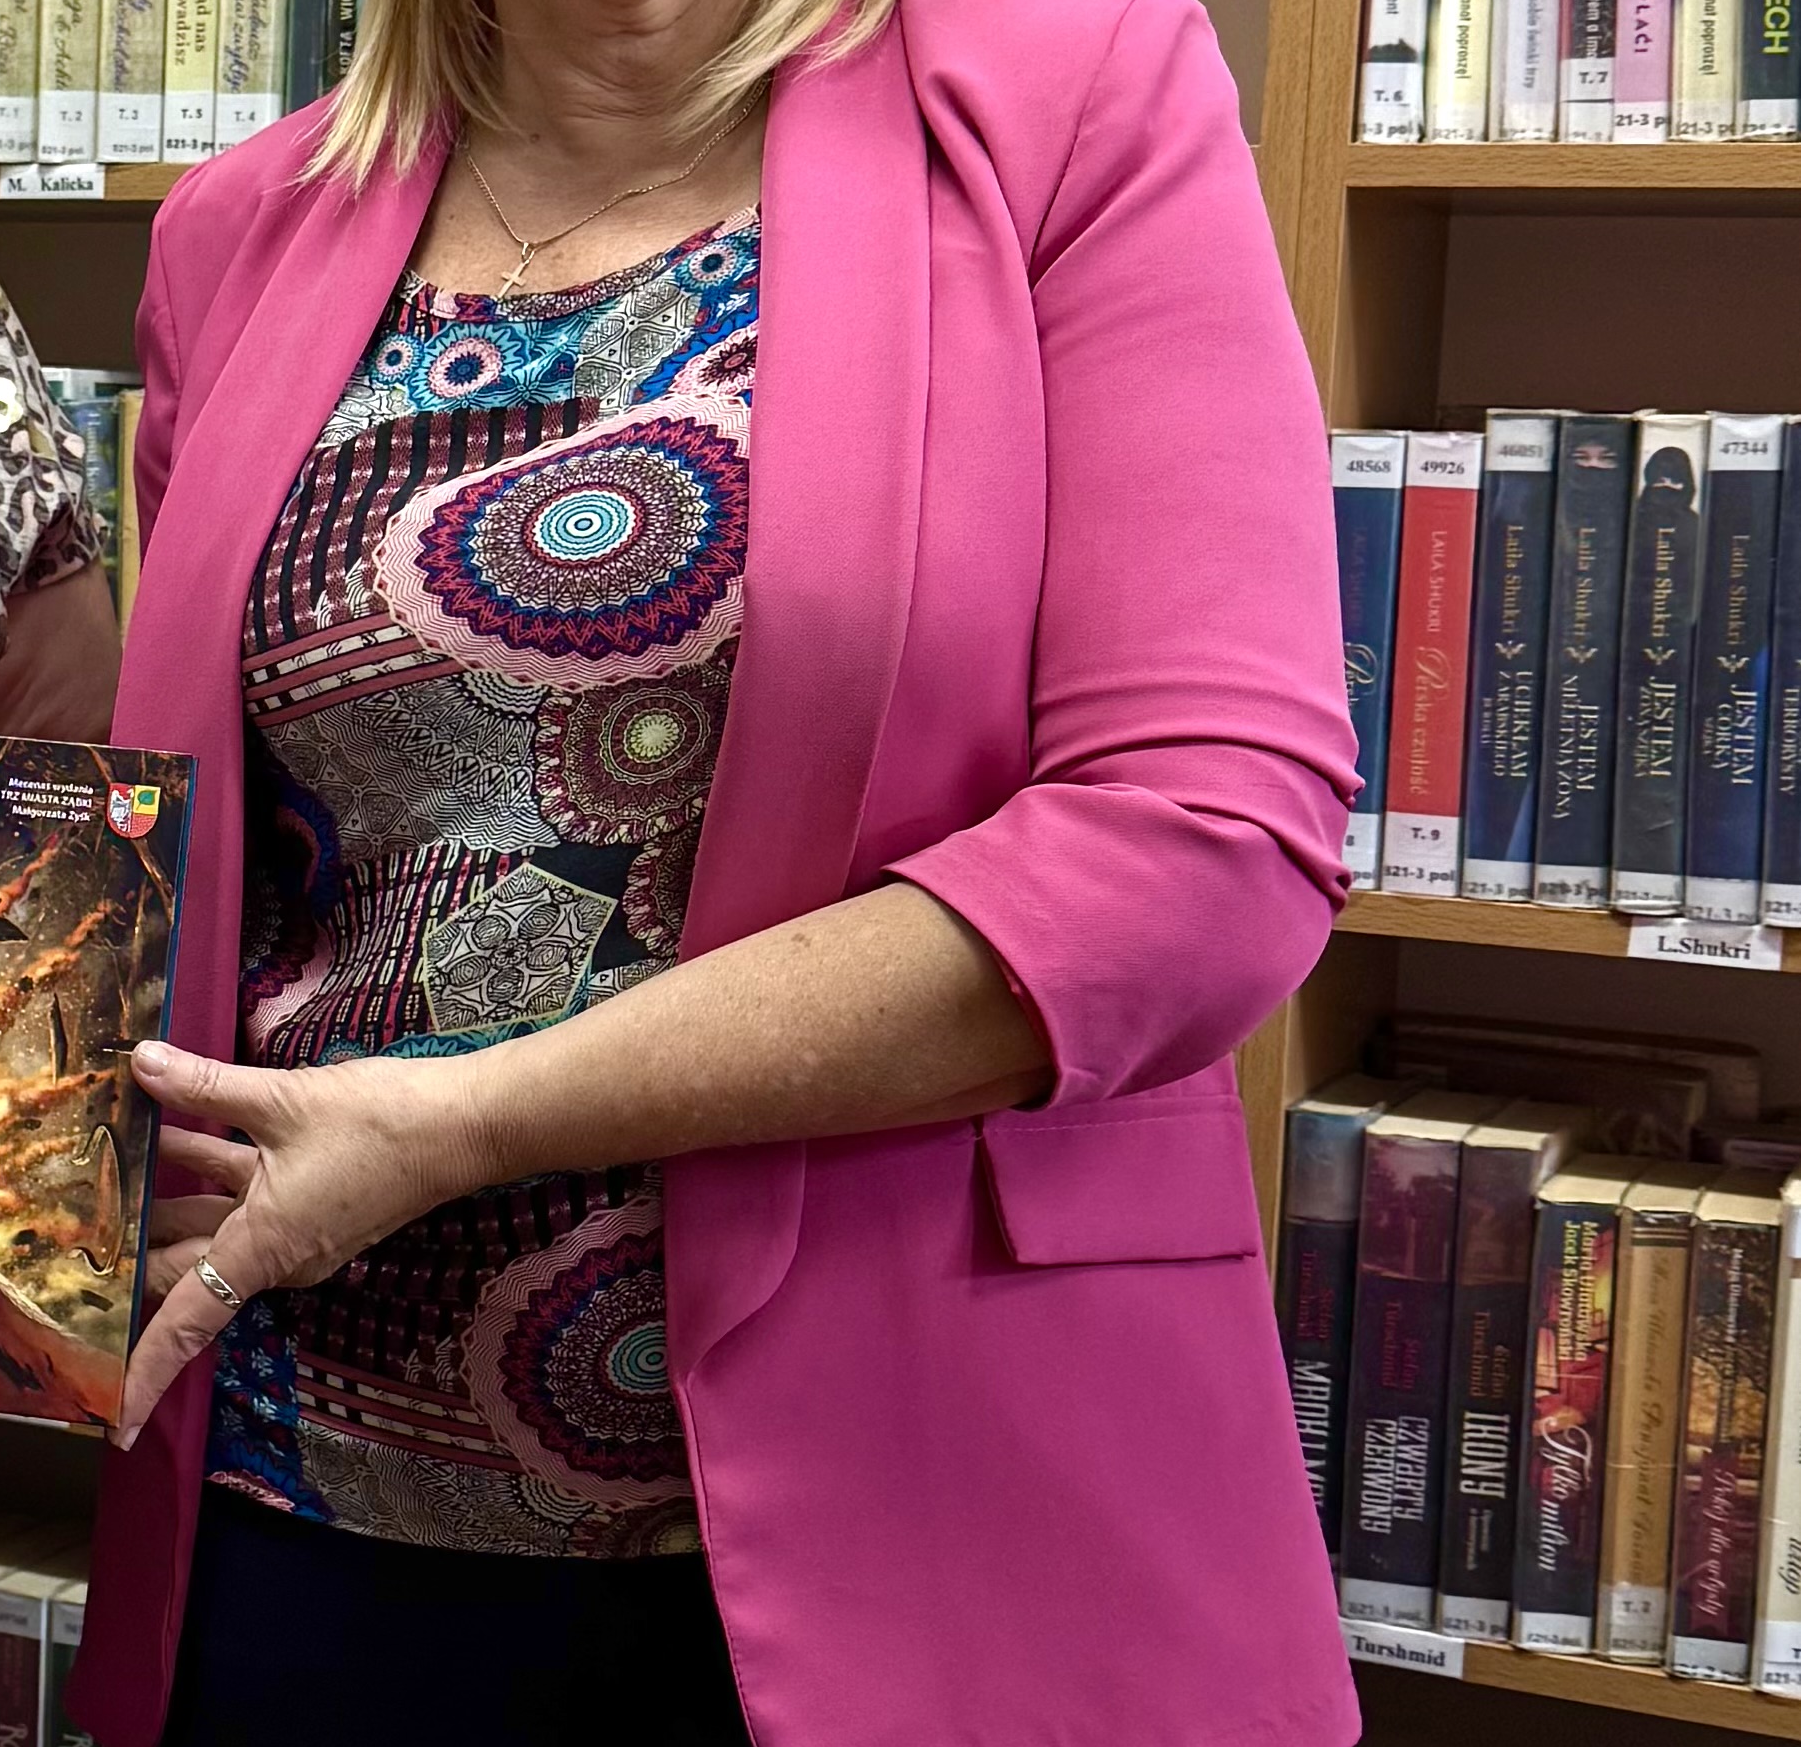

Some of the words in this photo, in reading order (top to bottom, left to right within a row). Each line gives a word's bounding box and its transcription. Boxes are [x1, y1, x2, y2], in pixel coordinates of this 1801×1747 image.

[7, 177, 25, 194] M.
[40, 176, 95, 194] Kalicka
[1345, 458, 1392, 475] 48568
[1419, 459, 1466, 477] 49926
[1650, 675, 1677, 779] JESTEM
[1656, 934, 1753, 961] L.Shukri
[1352, 1633, 1447, 1669] Turshmid
